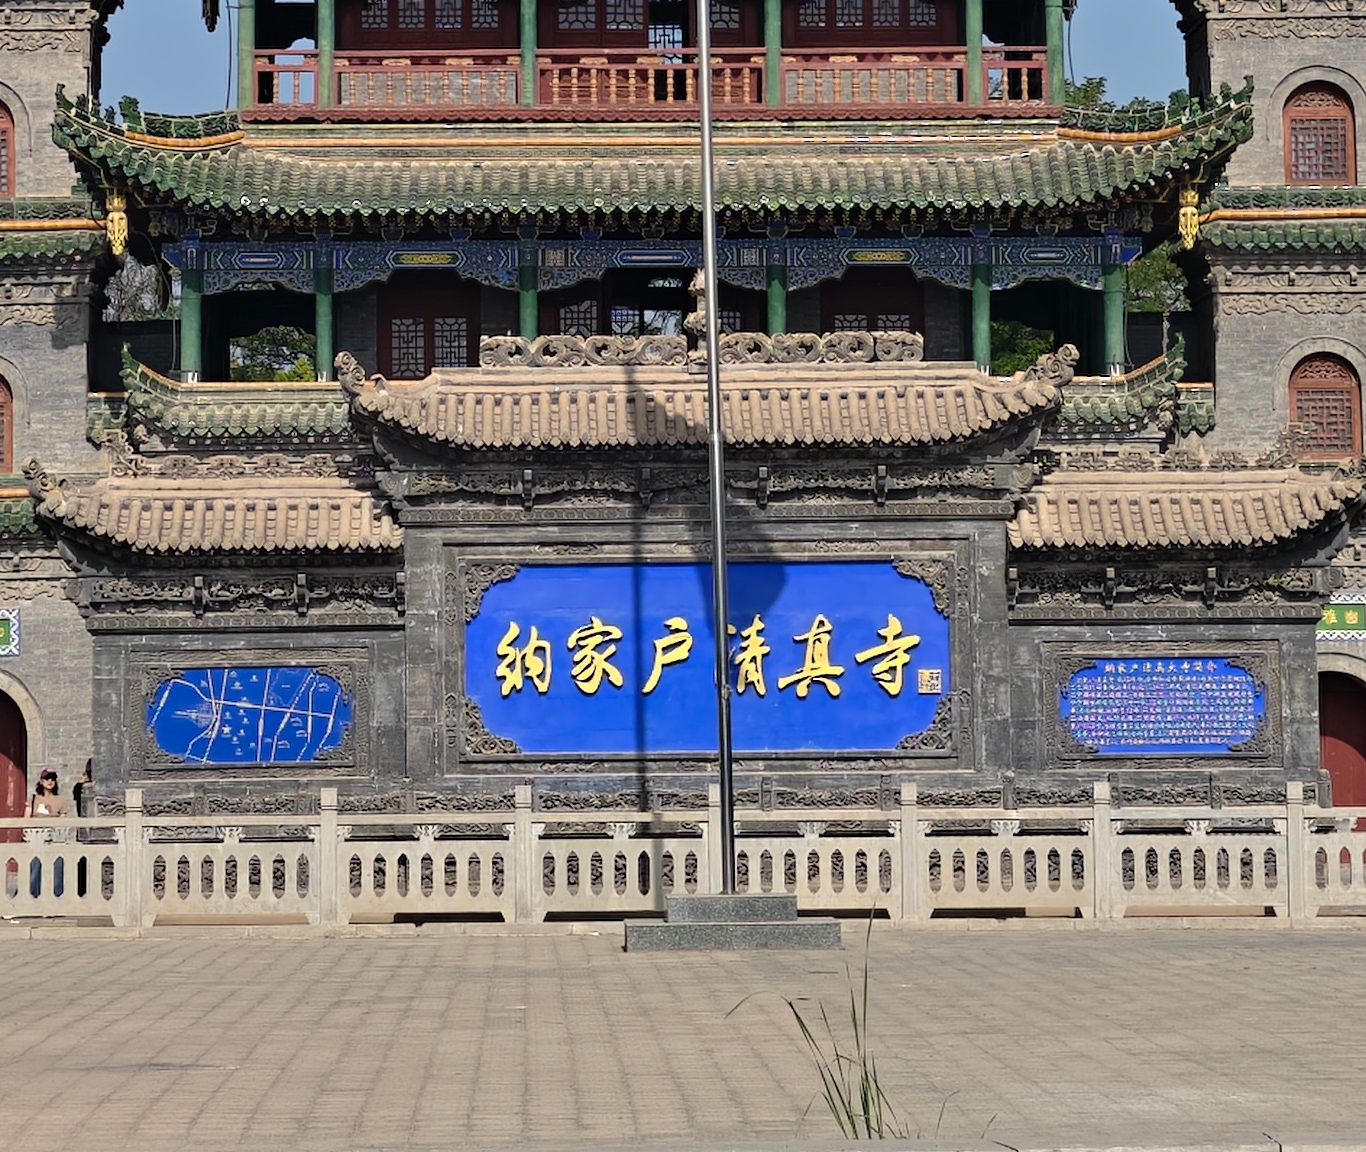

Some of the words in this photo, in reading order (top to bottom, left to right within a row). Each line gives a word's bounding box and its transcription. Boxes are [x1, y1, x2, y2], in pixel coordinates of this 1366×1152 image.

[495, 615, 920, 696] 纳家户清真寺
